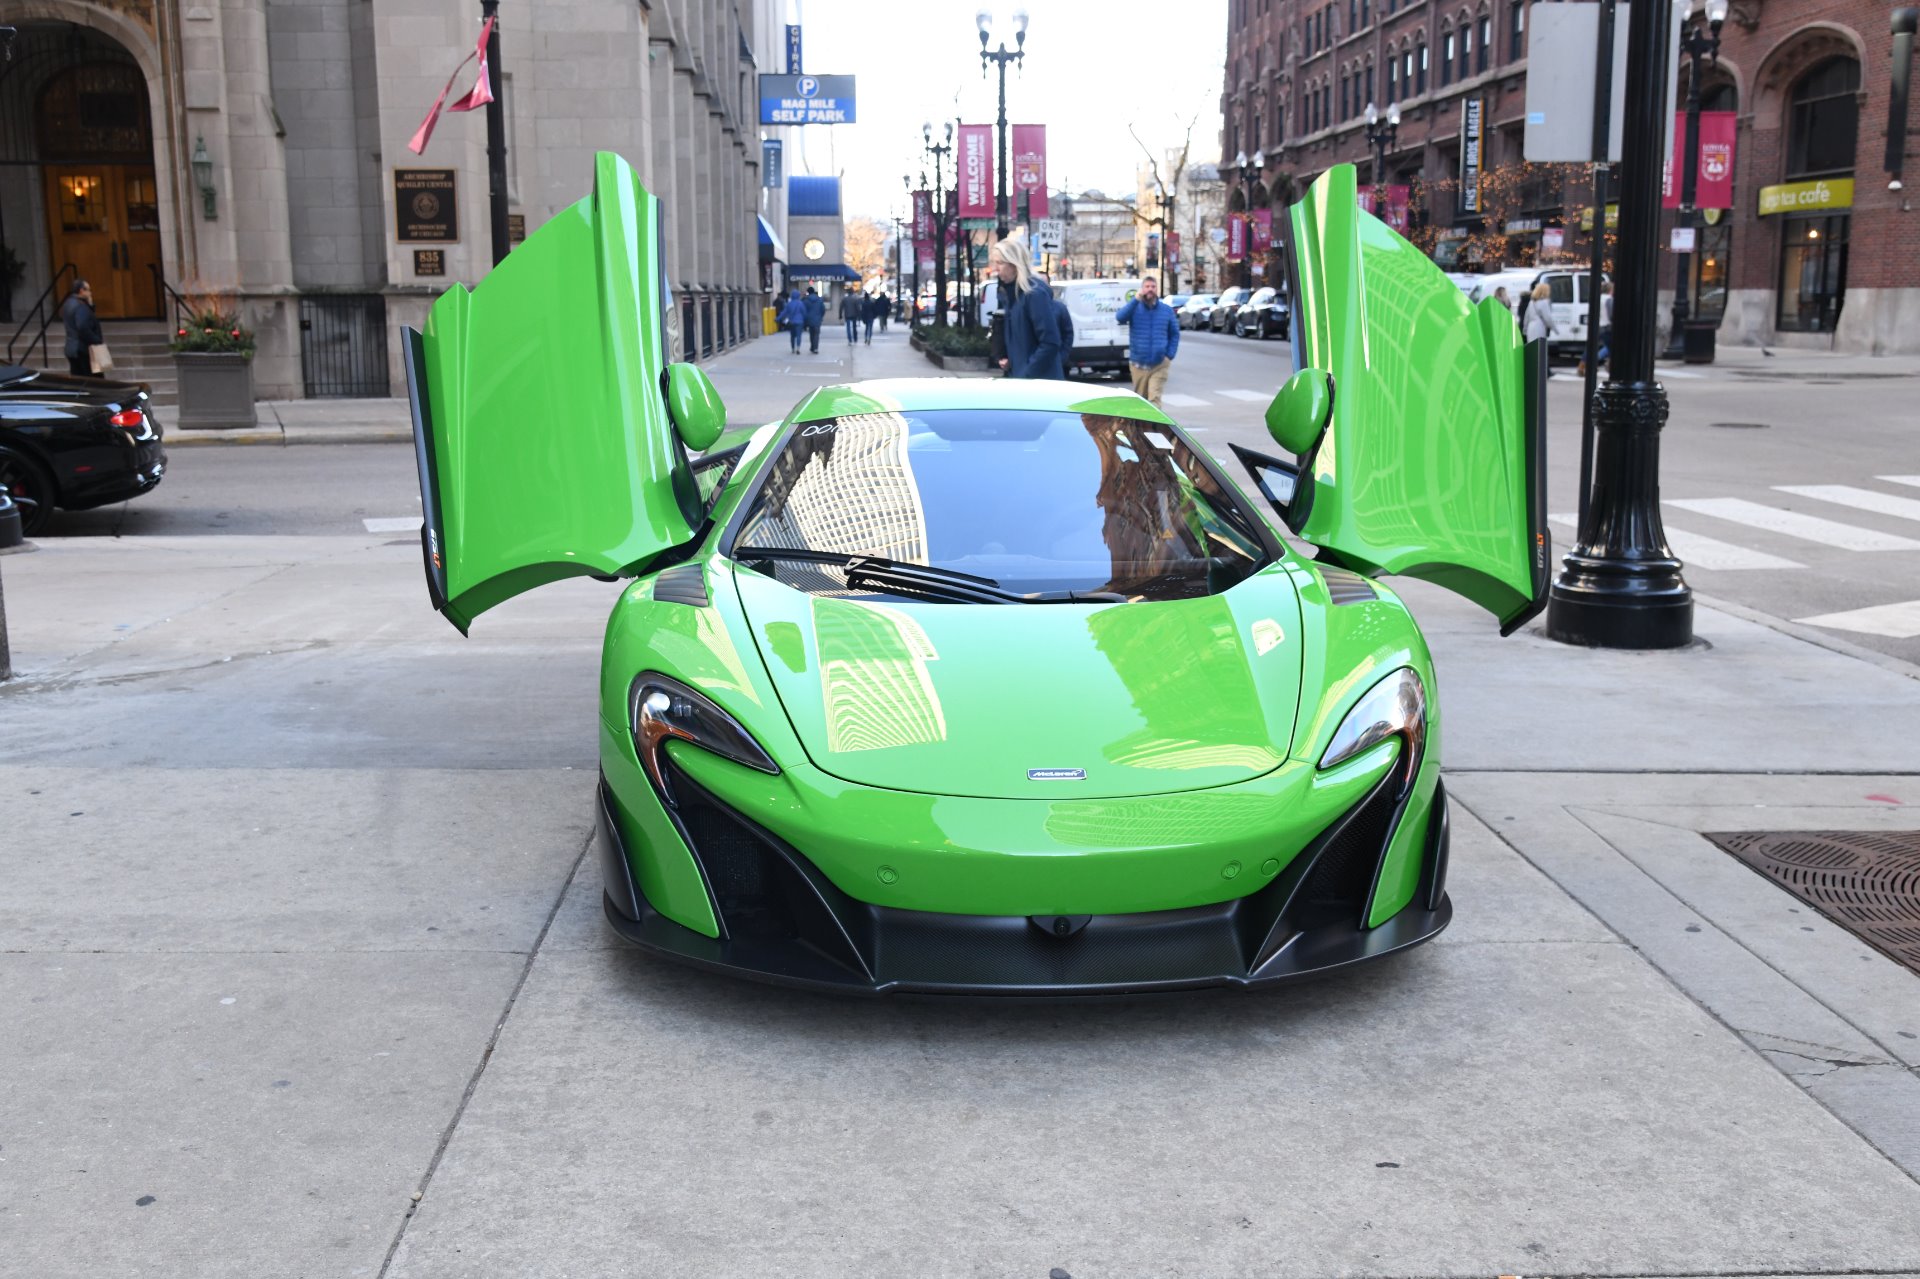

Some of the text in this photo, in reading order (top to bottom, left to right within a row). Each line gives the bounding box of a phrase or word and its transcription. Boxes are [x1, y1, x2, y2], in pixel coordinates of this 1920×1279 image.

[802, 79, 815, 95] P
[781, 99, 836, 109] MAG MILE
[772, 109, 845, 122] SELF PARK
[1468, 100, 1480, 138] BAGELS
[967, 134, 980, 206] WELCOME
[1799, 181, 1831, 204] café
[1041, 222, 1061, 231] ONE
[1041, 232, 1060, 241] WAY
[419, 251, 439, 263] 835
